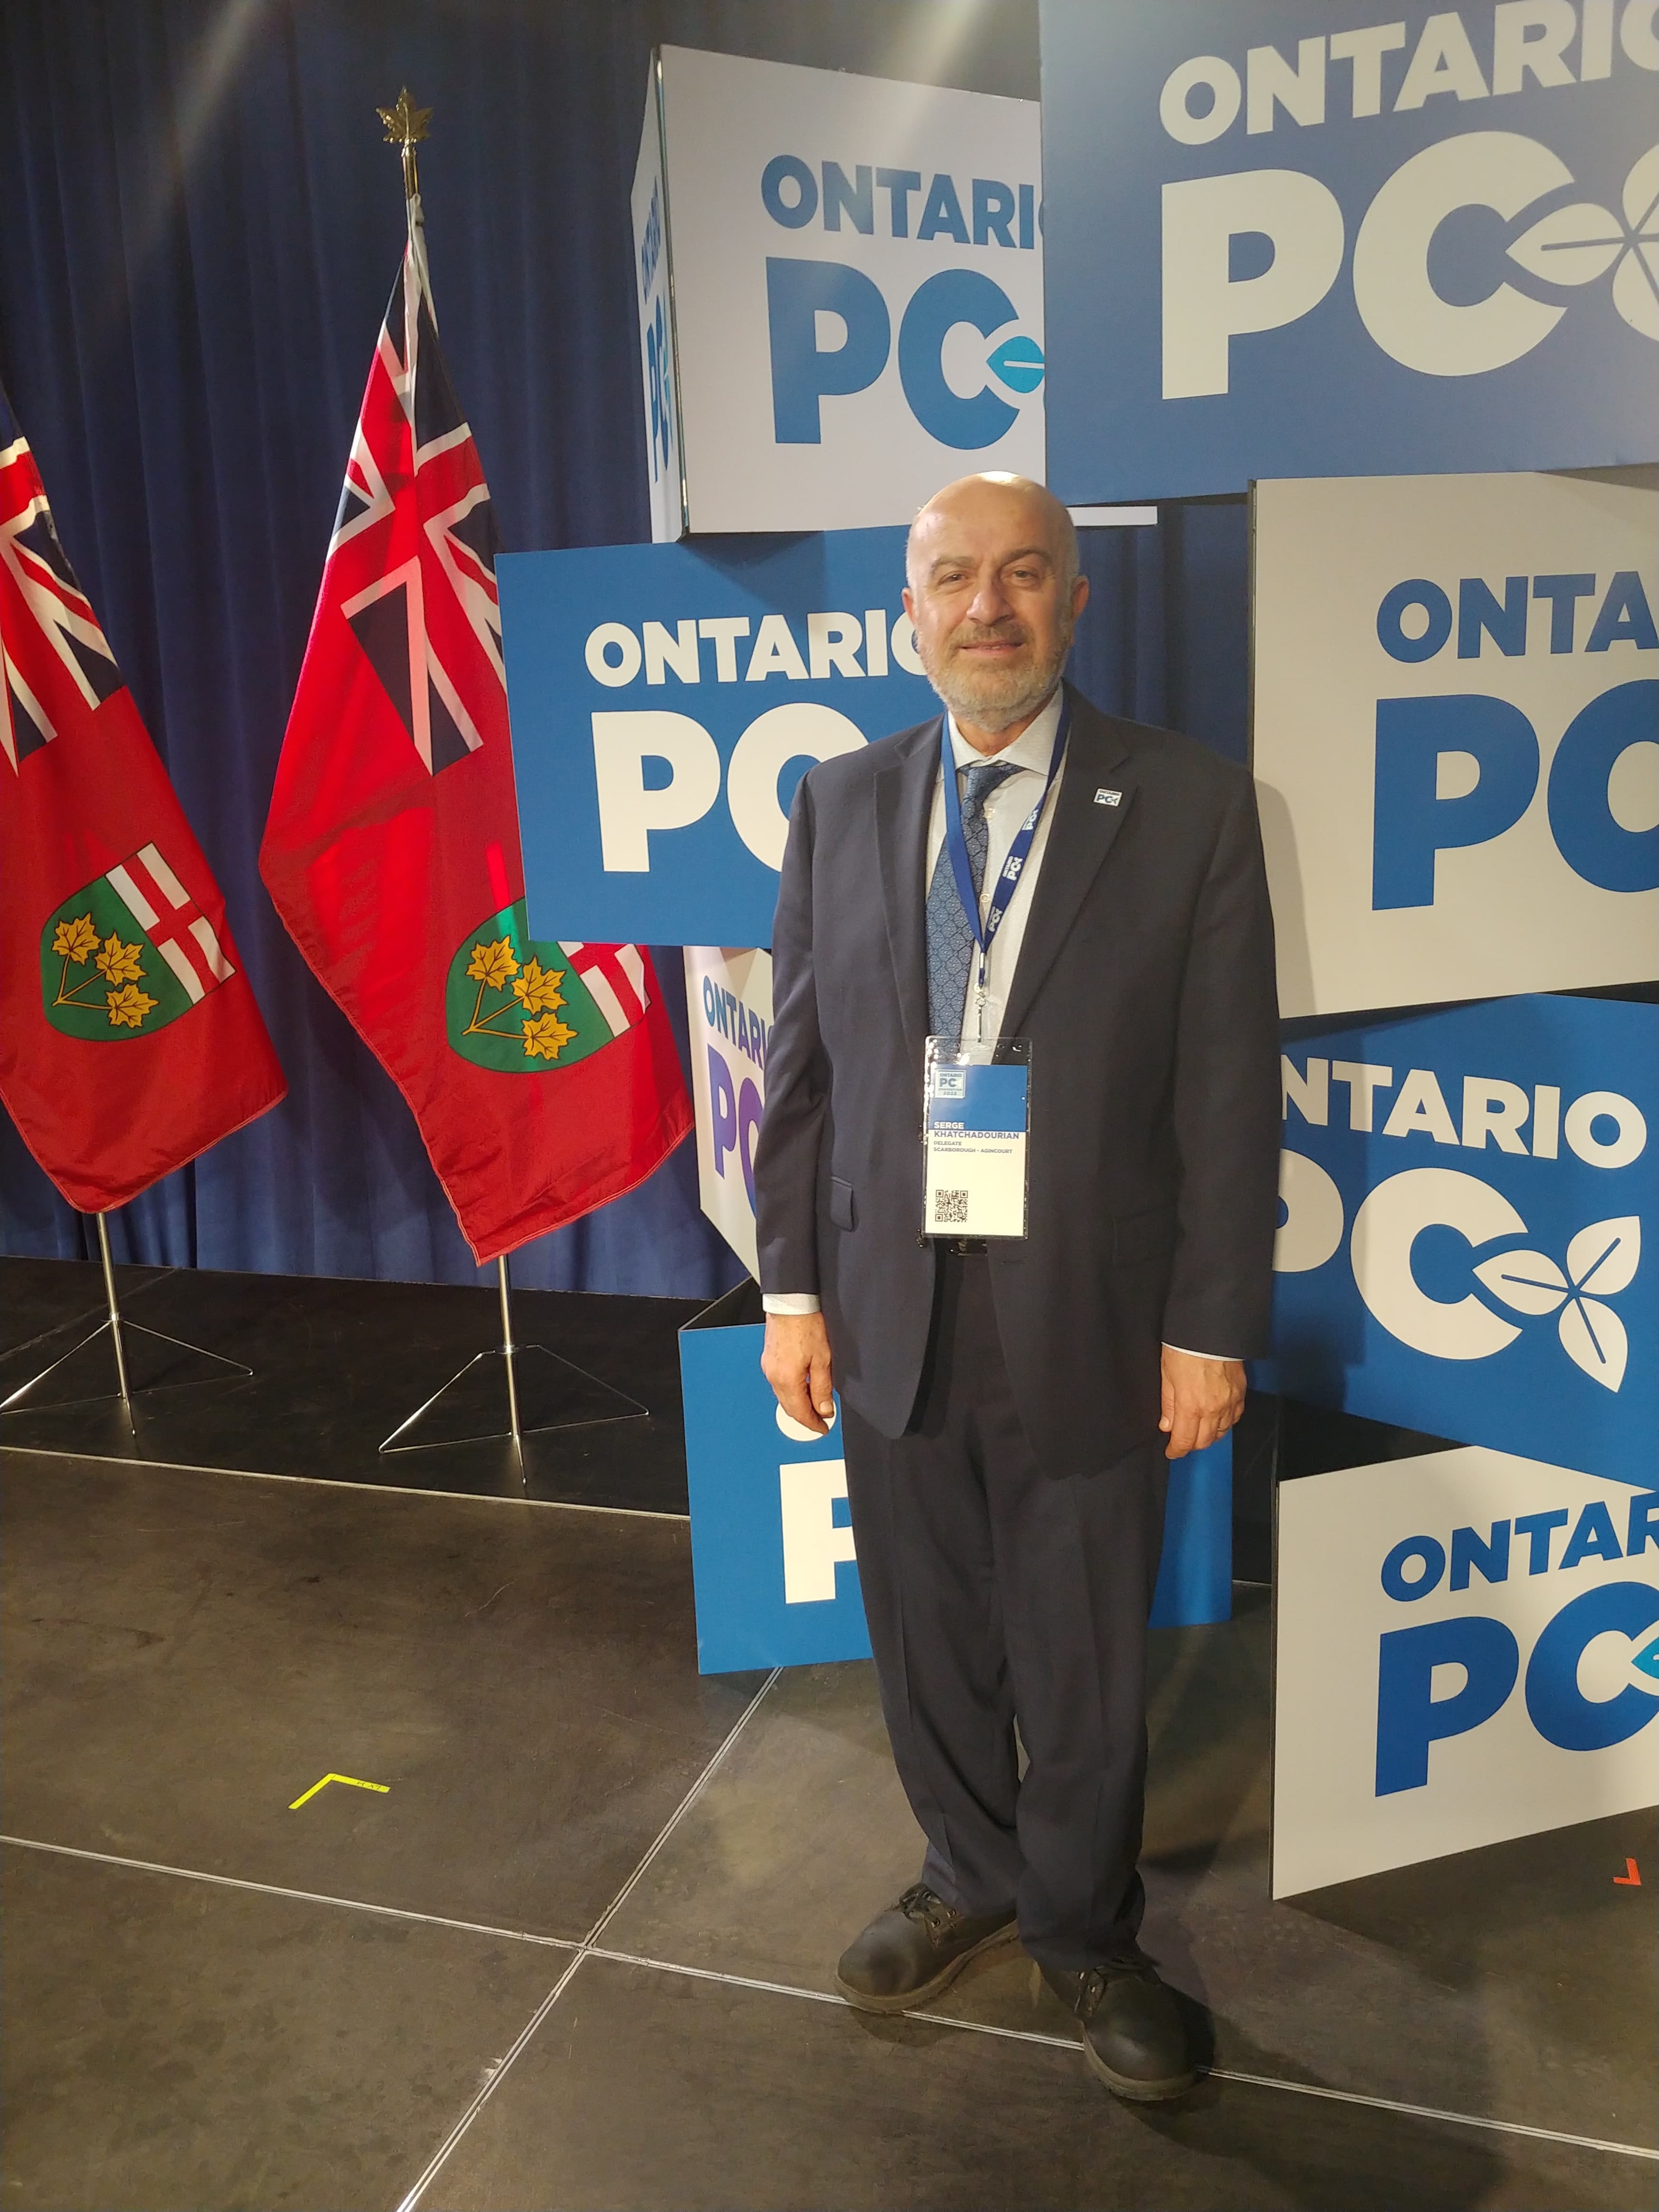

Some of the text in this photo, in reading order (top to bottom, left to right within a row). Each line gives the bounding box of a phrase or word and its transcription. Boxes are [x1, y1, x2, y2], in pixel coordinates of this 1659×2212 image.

[761, 154, 1044, 249] ONTARI
[1162, 131, 1575, 400] PC
[765, 257, 1020, 450] PC
[1377, 572, 1659, 663] ONTA
[1096, 793, 1113, 803] PC
[703, 974, 774, 1071] ONTARI
[934, 1121, 964, 1129] SERGE
[939, 1077, 957, 1087] PC
[1280, 1054, 1647, 1169] NTARIO
[934, 1131, 1019, 1139] KHATCHADOURIAN
[1375, 1581, 1659, 1797] PC
